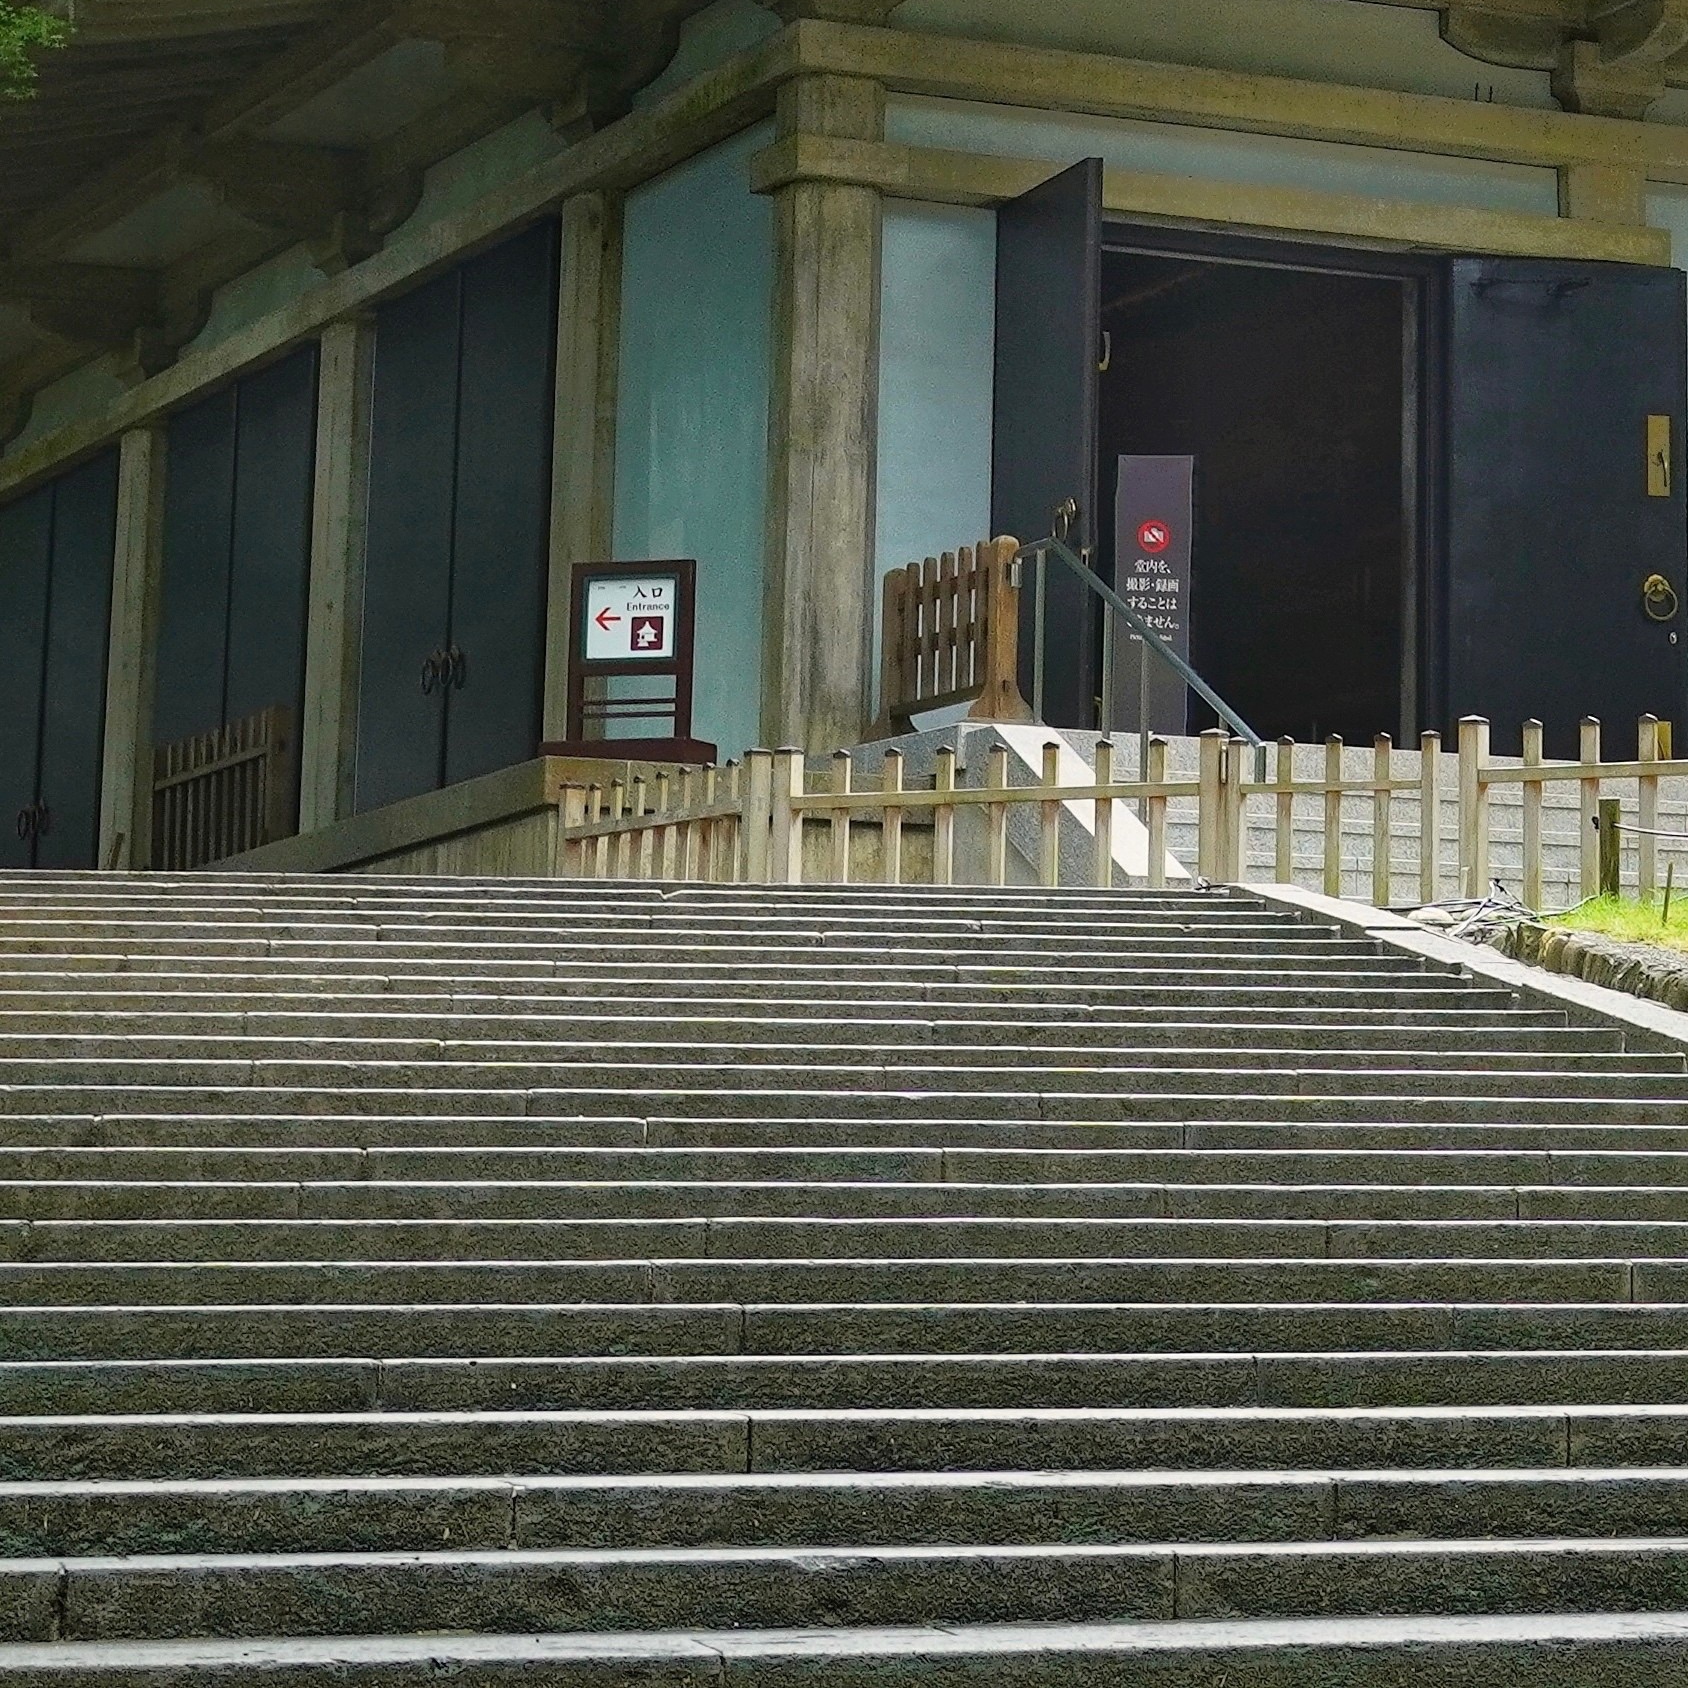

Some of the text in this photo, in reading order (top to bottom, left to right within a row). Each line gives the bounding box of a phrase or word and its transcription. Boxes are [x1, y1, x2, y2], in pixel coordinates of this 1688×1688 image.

[633, 585, 663, 598] 入口
[1126, 577, 1180, 593] 撮影・録画
[626, 602, 670, 611] Entrance
[1127, 596, 1177, 610] することは
[1127, 614, 1180, 630] ません。
